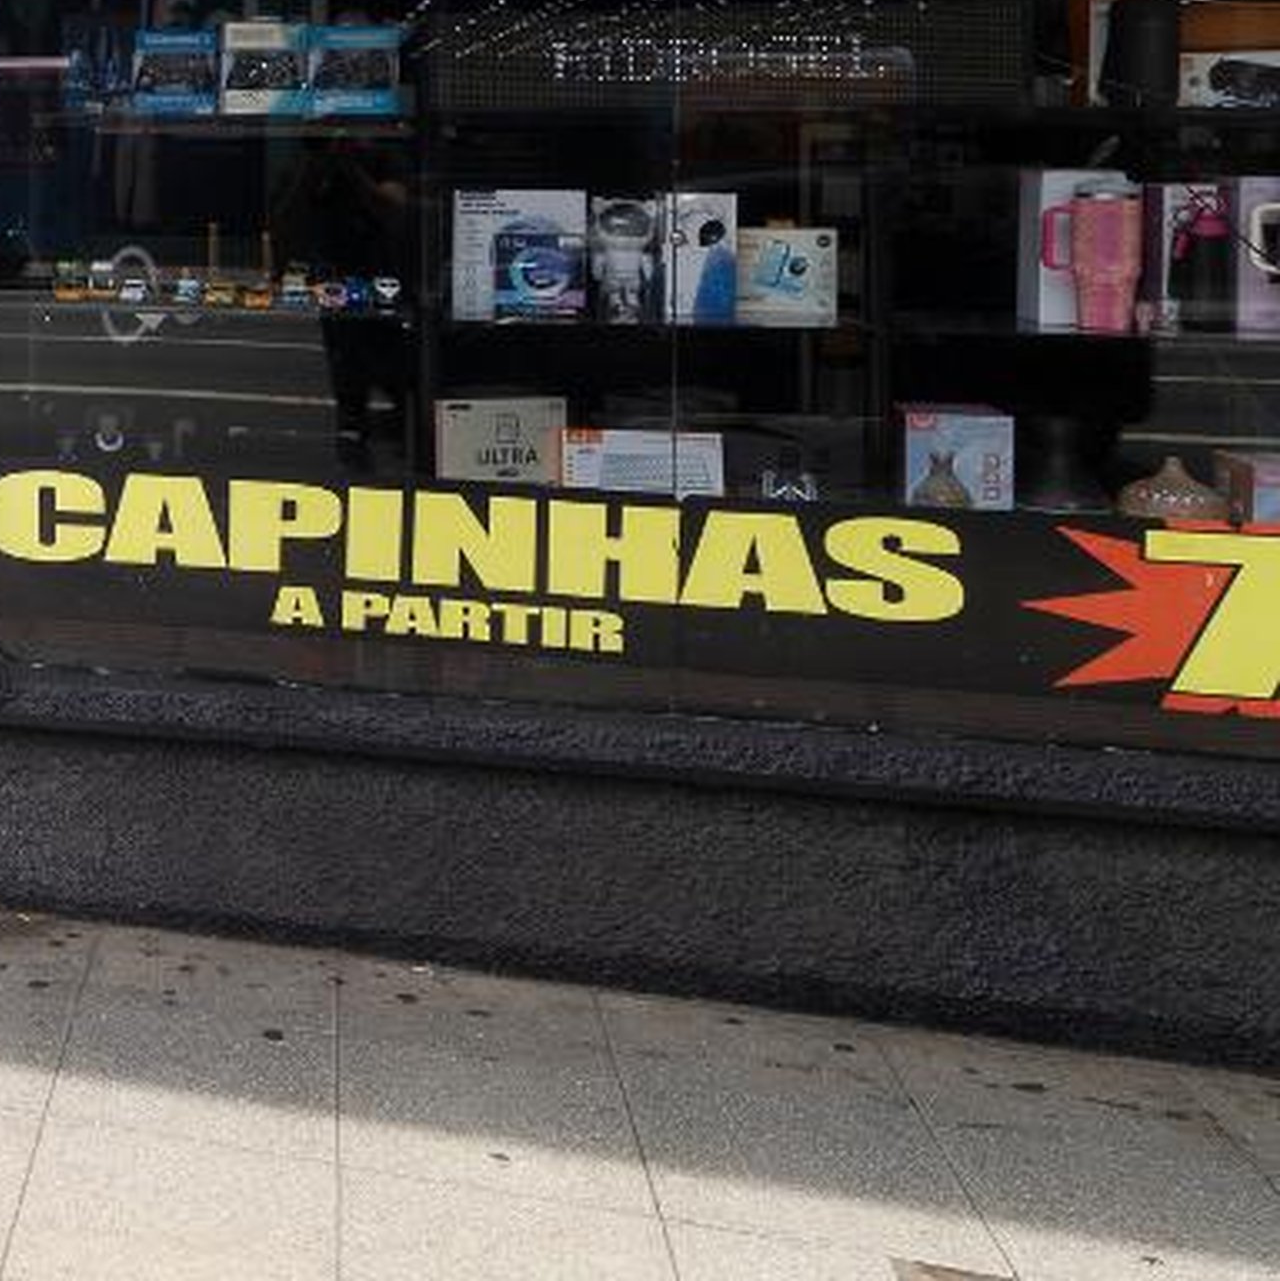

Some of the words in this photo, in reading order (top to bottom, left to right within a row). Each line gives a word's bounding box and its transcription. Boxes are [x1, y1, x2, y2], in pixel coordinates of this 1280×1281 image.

[478, 446, 537, 465] ULTRA
[271, 586, 317, 627] A
[342, 591, 624, 653] PARTIR
